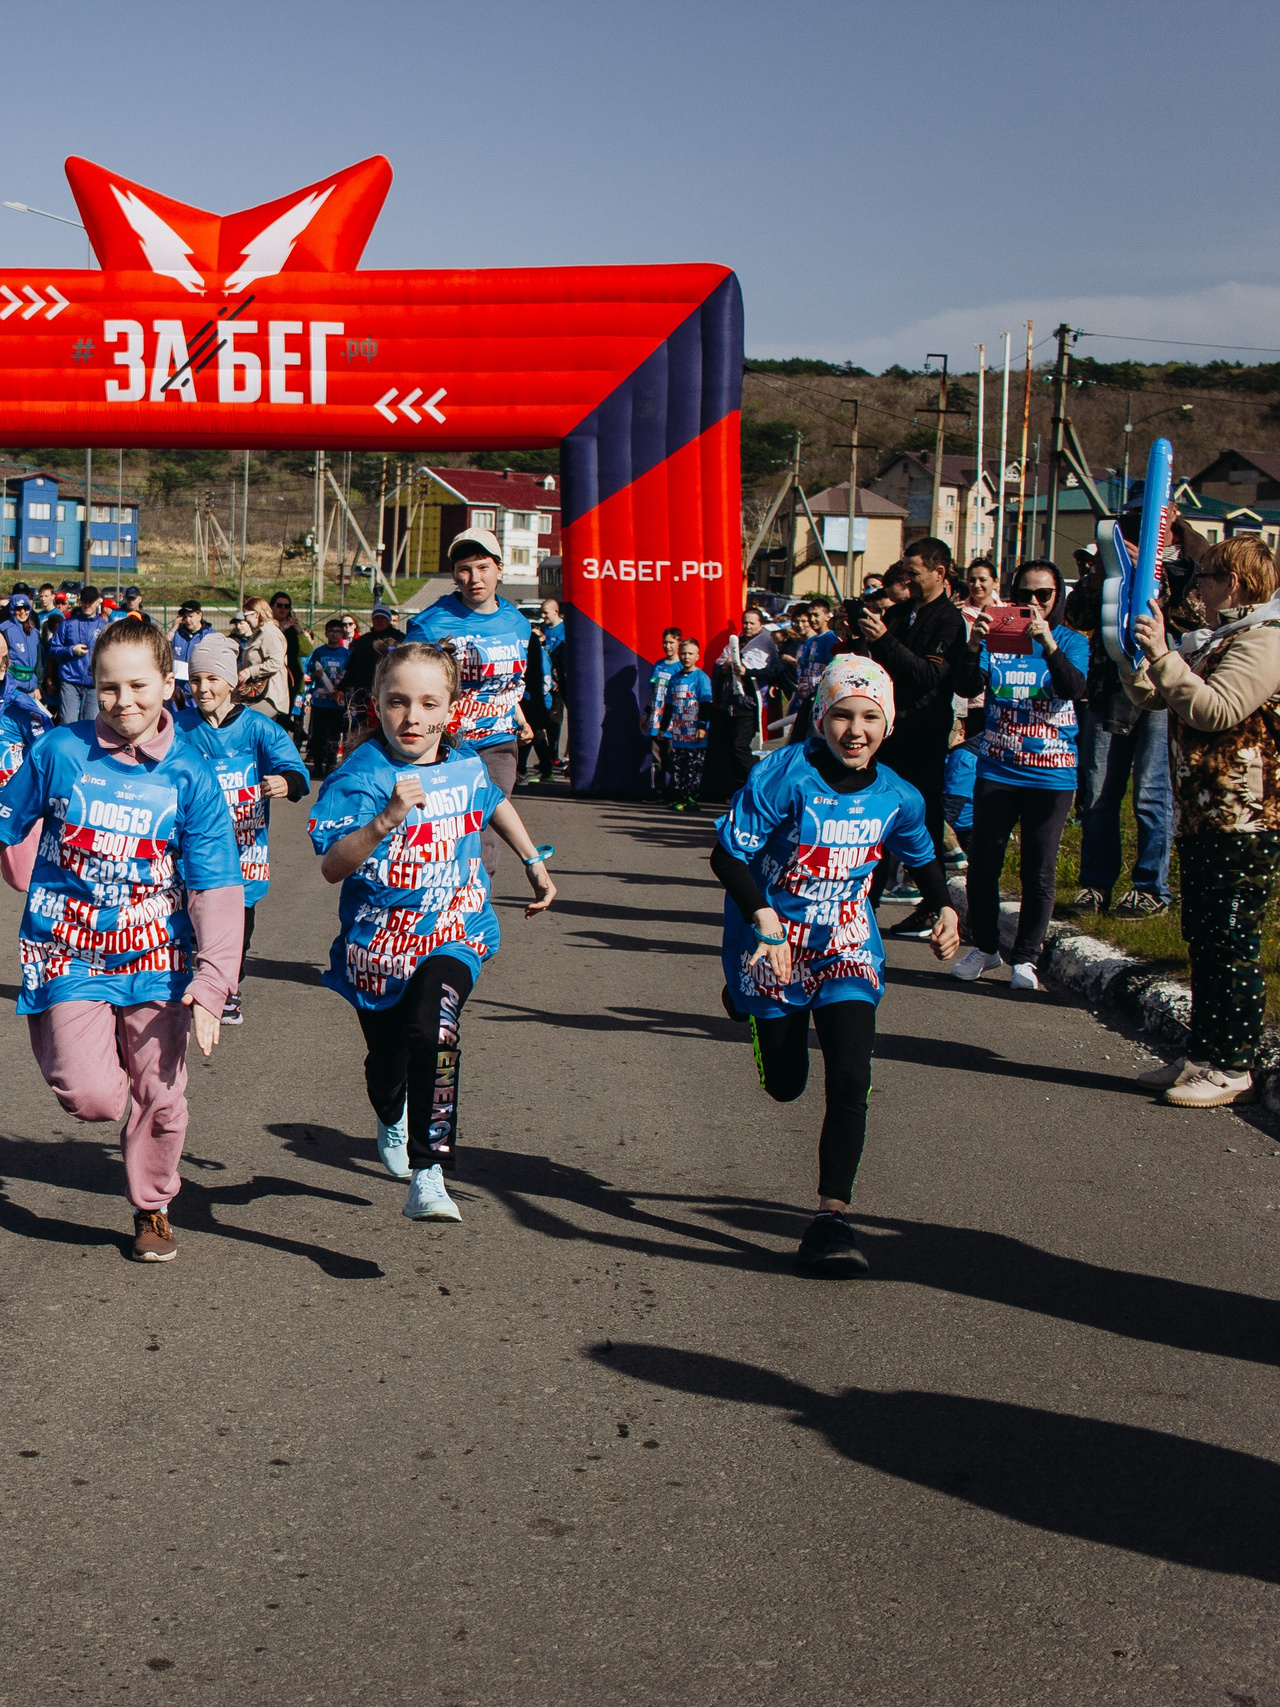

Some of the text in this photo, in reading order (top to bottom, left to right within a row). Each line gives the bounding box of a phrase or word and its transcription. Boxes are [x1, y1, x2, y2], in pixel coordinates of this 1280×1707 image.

[582, 557, 723, 582] ЗАБЕГ.РФ
[1005, 671, 1036, 685] 10019
[218, 771, 243, 790] 526
[424, 785, 468, 818] 00517
[88, 800, 152, 835] 00513
[432, 815, 465, 842] 500М
[91, 830, 140, 858] 500М
[821, 819, 882, 844] 00520
[240, 845, 267, 863] 2024
[828, 846, 869, 869] 500М
[30, 887, 99, 930] #ЗАБЕГ
[52, 918, 169, 954] #ГОРДОСТЬ
[428, 1051, 458, 1153] ENERGY
